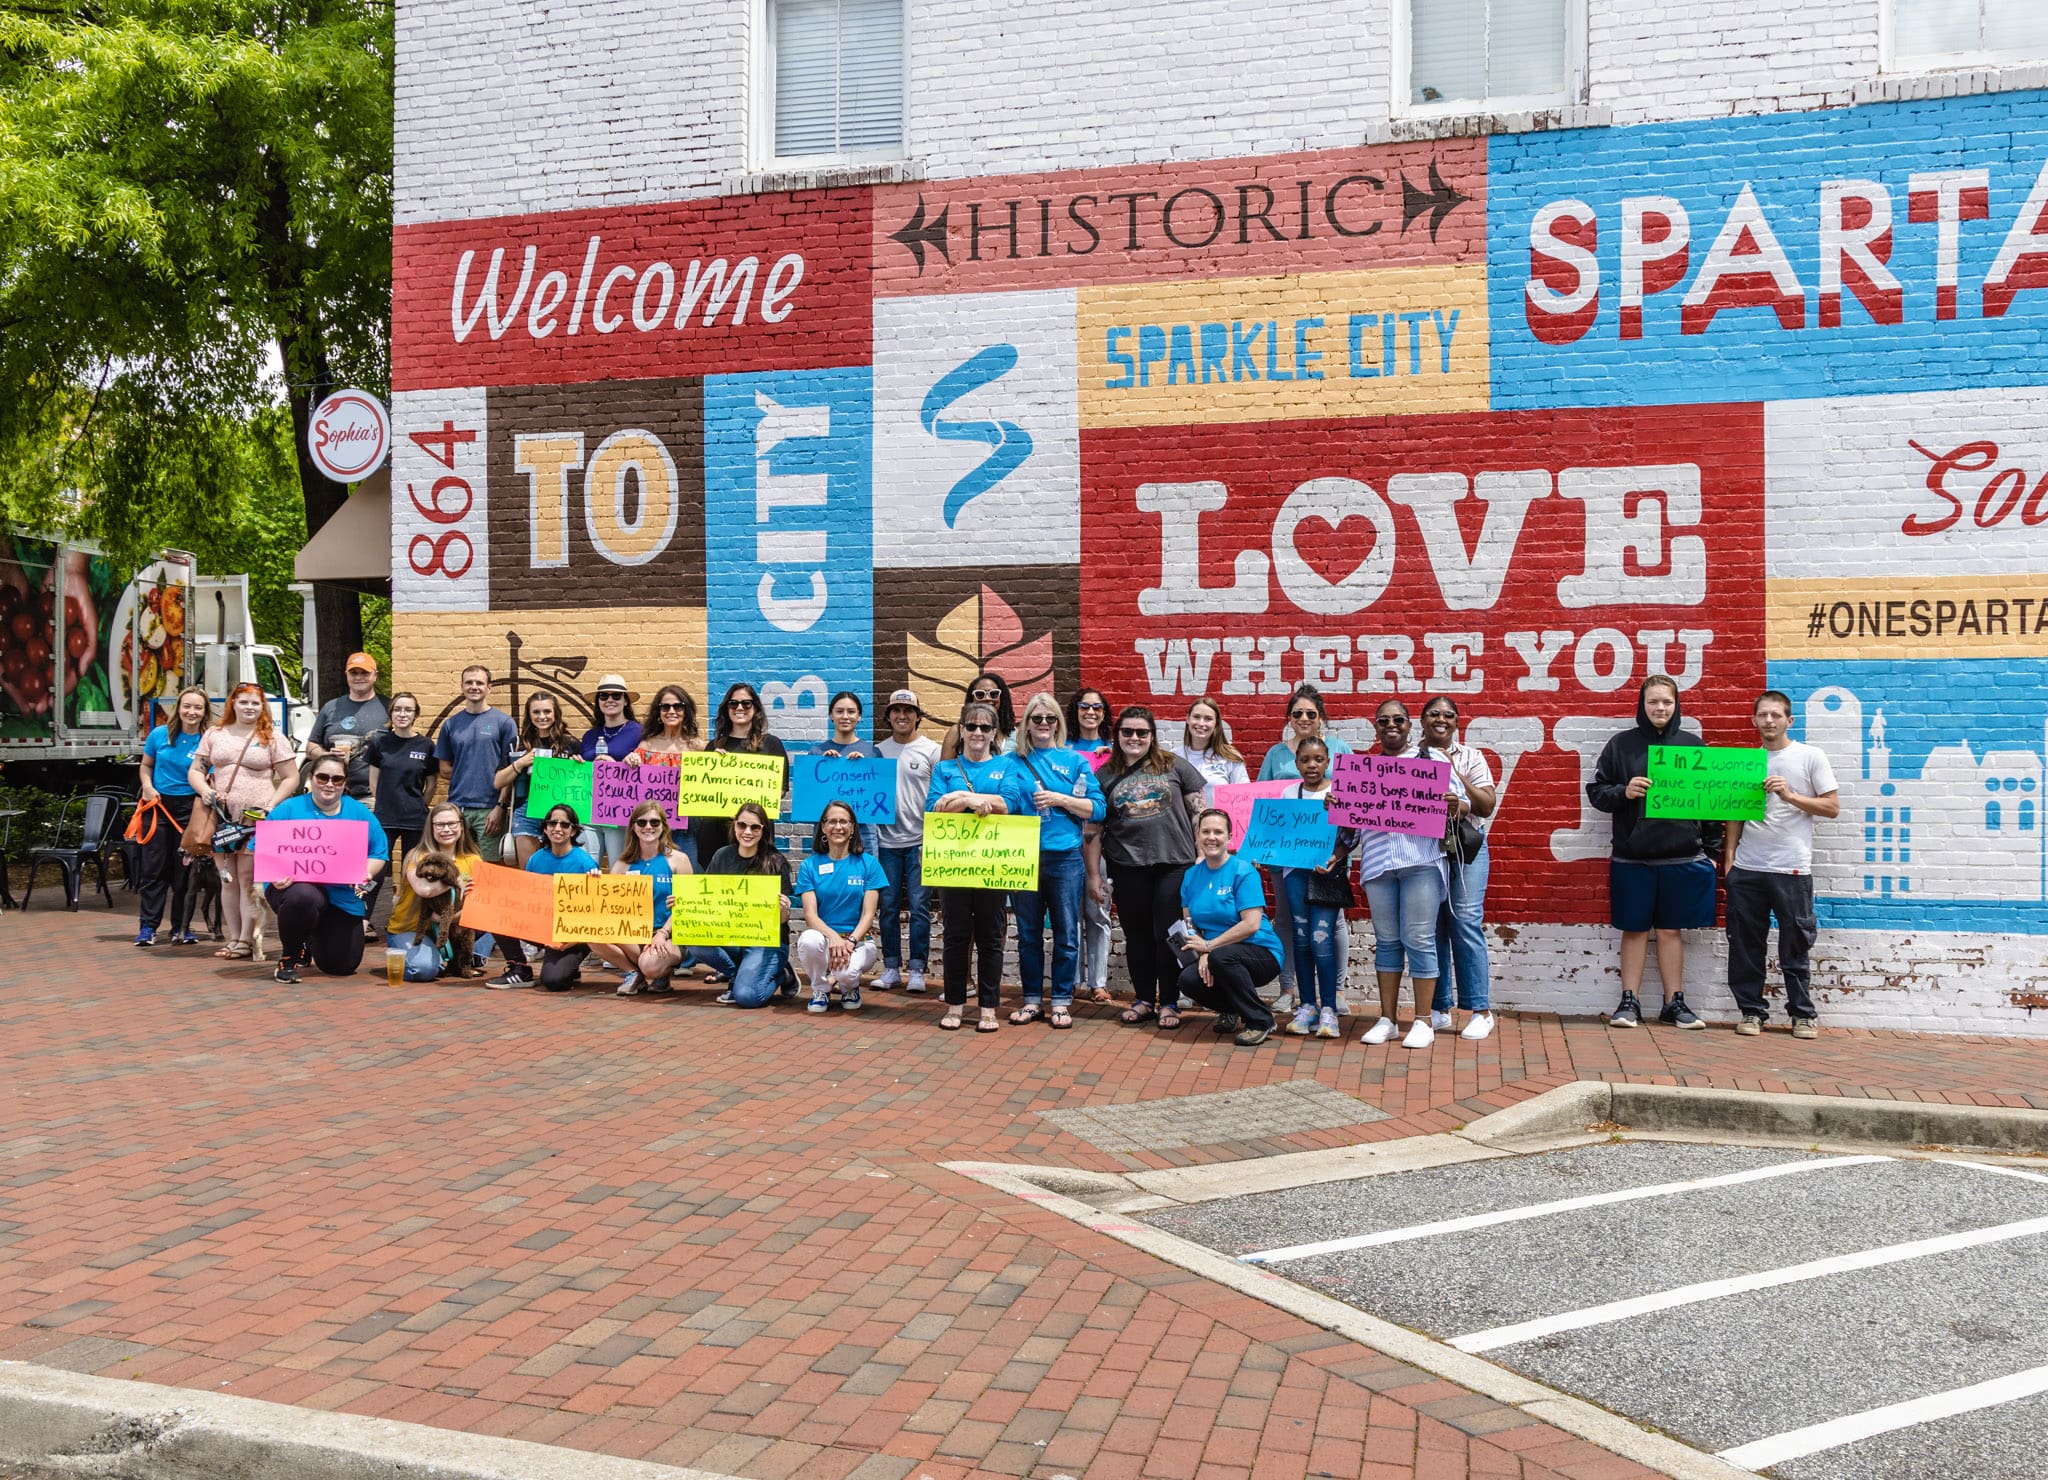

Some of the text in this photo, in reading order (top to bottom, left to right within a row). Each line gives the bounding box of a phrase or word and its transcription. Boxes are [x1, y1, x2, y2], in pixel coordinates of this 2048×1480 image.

[967, 174, 1385, 262] HISTORIC
[452, 236, 804, 343] Welcome
[1105, 309, 1462, 389] SPARKLE CITY
[314, 419, 379, 452] Sophia's
[407, 419, 477, 580] 864
[514, 429, 679, 570] TO
[755, 388, 831, 633] CITY
[1136, 463, 1707, 616] LOVE
[1135, 627, 1714, 697] WHERE YOU
[536, 759, 593, 781] Consen
[683, 756, 780, 774] every 68 seconds
[1335, 753, 1438, 780] 1 in 9 girls and
[1654, 747, 1765, 774] 1 in 2 women
[648, 769, 681, 786] with
[683, 772, 778, 790] an American is
[814, 759, 880, 784] Consent
[1650, 772, 1687, 789] have
[1334, 779, 1344, 793] 1
[1347, 781, 1359, 793] in
[1360, 781, 1377, 796] 53
[1380, 782, 1409, 799] boys
[682, 792, 780, 809] sexually assaulted
[1354, 801, 1375, 814] age
[1375, 799, 1388, 810] of
[1391, 800, 1401, 811] 18
[1258, 804, 1321, 829] Use your
[1385, 816, 1417, 829] abuse
[293, 826, 322, 841] NO
[932, 818, 1001, 841] 35.6% of
[277, 845, 338, 856] means
[925, 846, 977, 861] Hispanic
[1294, 836, 1331, 851] prevent
[1261, 850, 1273, 863] it
[293, 859, 327, 876] NO
[557, 874, 590, 900] April
[596, 880, 609, 897] is
[699, 877, 749, 896] 1 in 4
[600, 898, 644, 917] Assault
[718, 899, 748, 911] college
[555, 917, 615, 937] Awareness
[617, 919, 651, 939] Month
[674, 920, 731, 929] experienced
